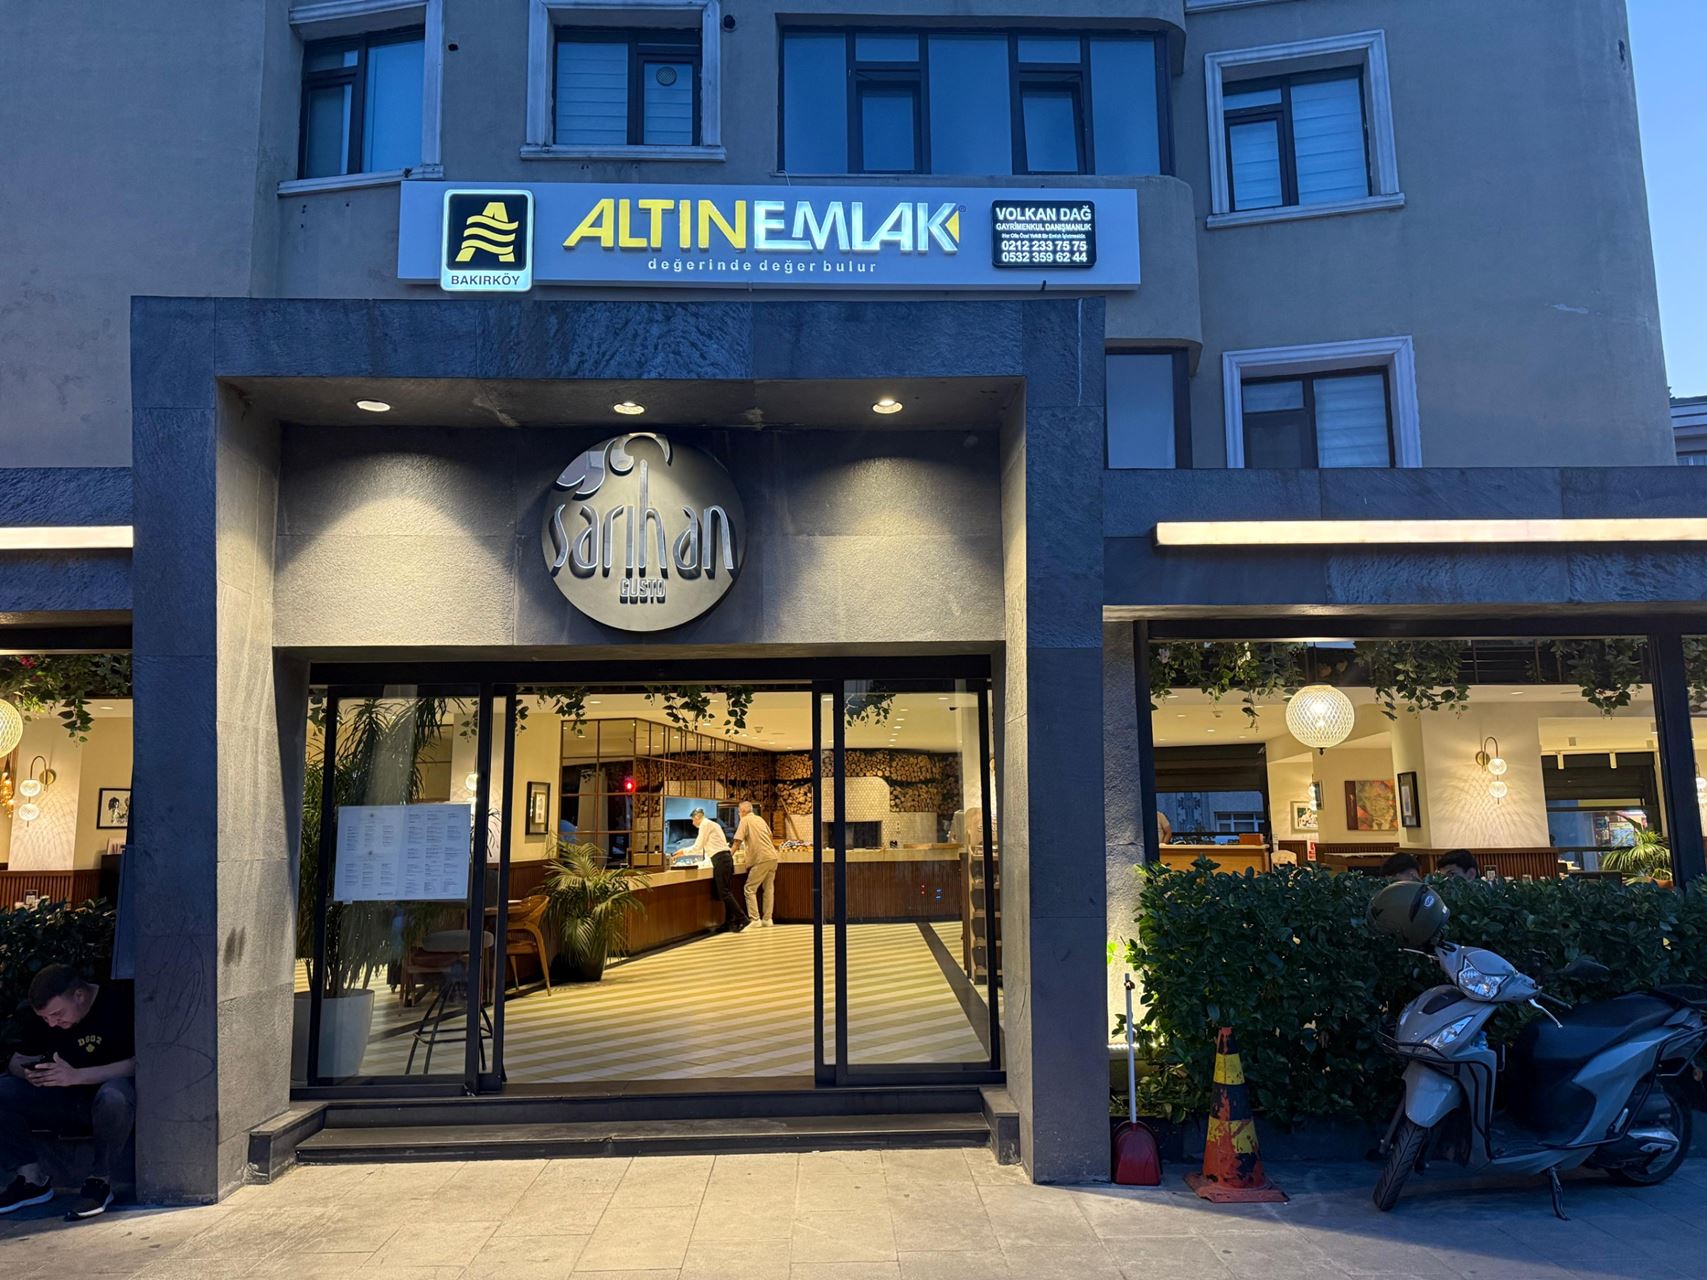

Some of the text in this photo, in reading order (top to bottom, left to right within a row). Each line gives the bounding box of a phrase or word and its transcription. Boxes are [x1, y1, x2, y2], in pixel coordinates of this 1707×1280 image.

[996, 205, 1092, 221] VOLKAN DAĞ
[1002, 240, 1088, 251] 0212 233 75 75
[1002, 252, 1088, 262] 0532 359 62 44
[647, 258, 877, 274] değerinde değer bulur
[451, 273, 521, 286] BAKIRKÖY
[620, 578, 666, 598] GUSTO
